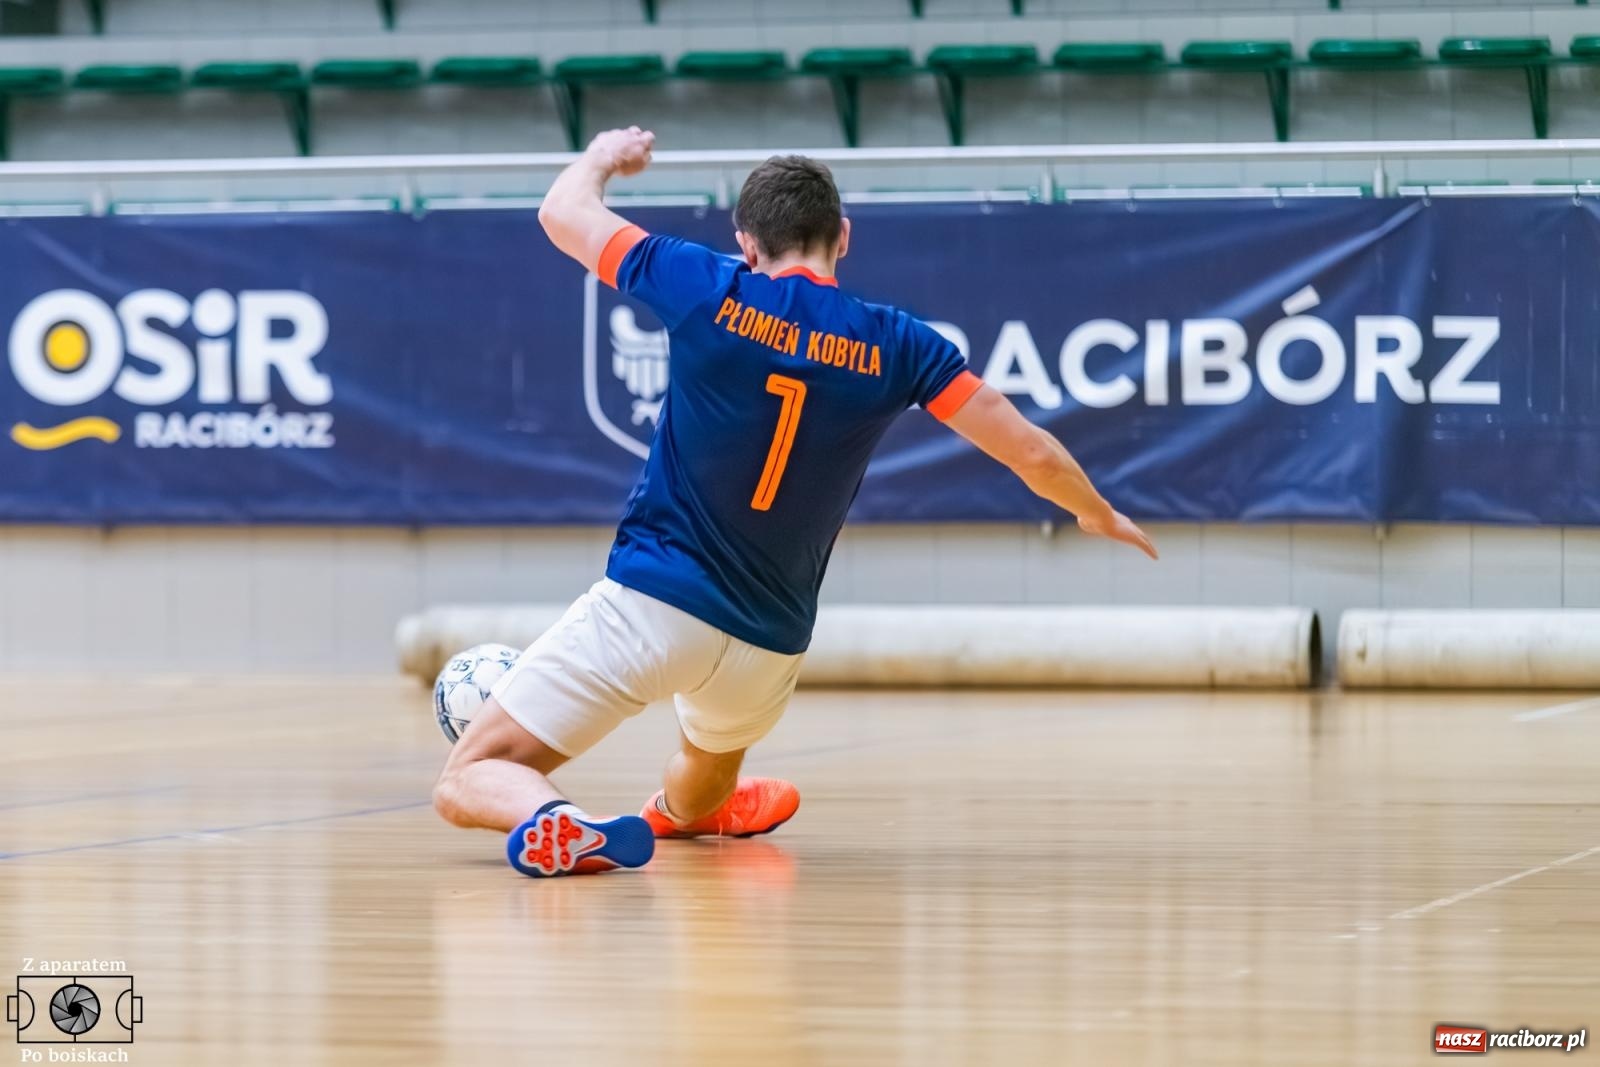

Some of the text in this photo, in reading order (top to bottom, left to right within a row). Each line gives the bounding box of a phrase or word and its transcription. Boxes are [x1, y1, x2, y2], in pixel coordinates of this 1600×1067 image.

[714, 297, 881, 376] PŁOMIEŃ KOBYLA
[134, 403, 335, 448] RACIBÓRZ
